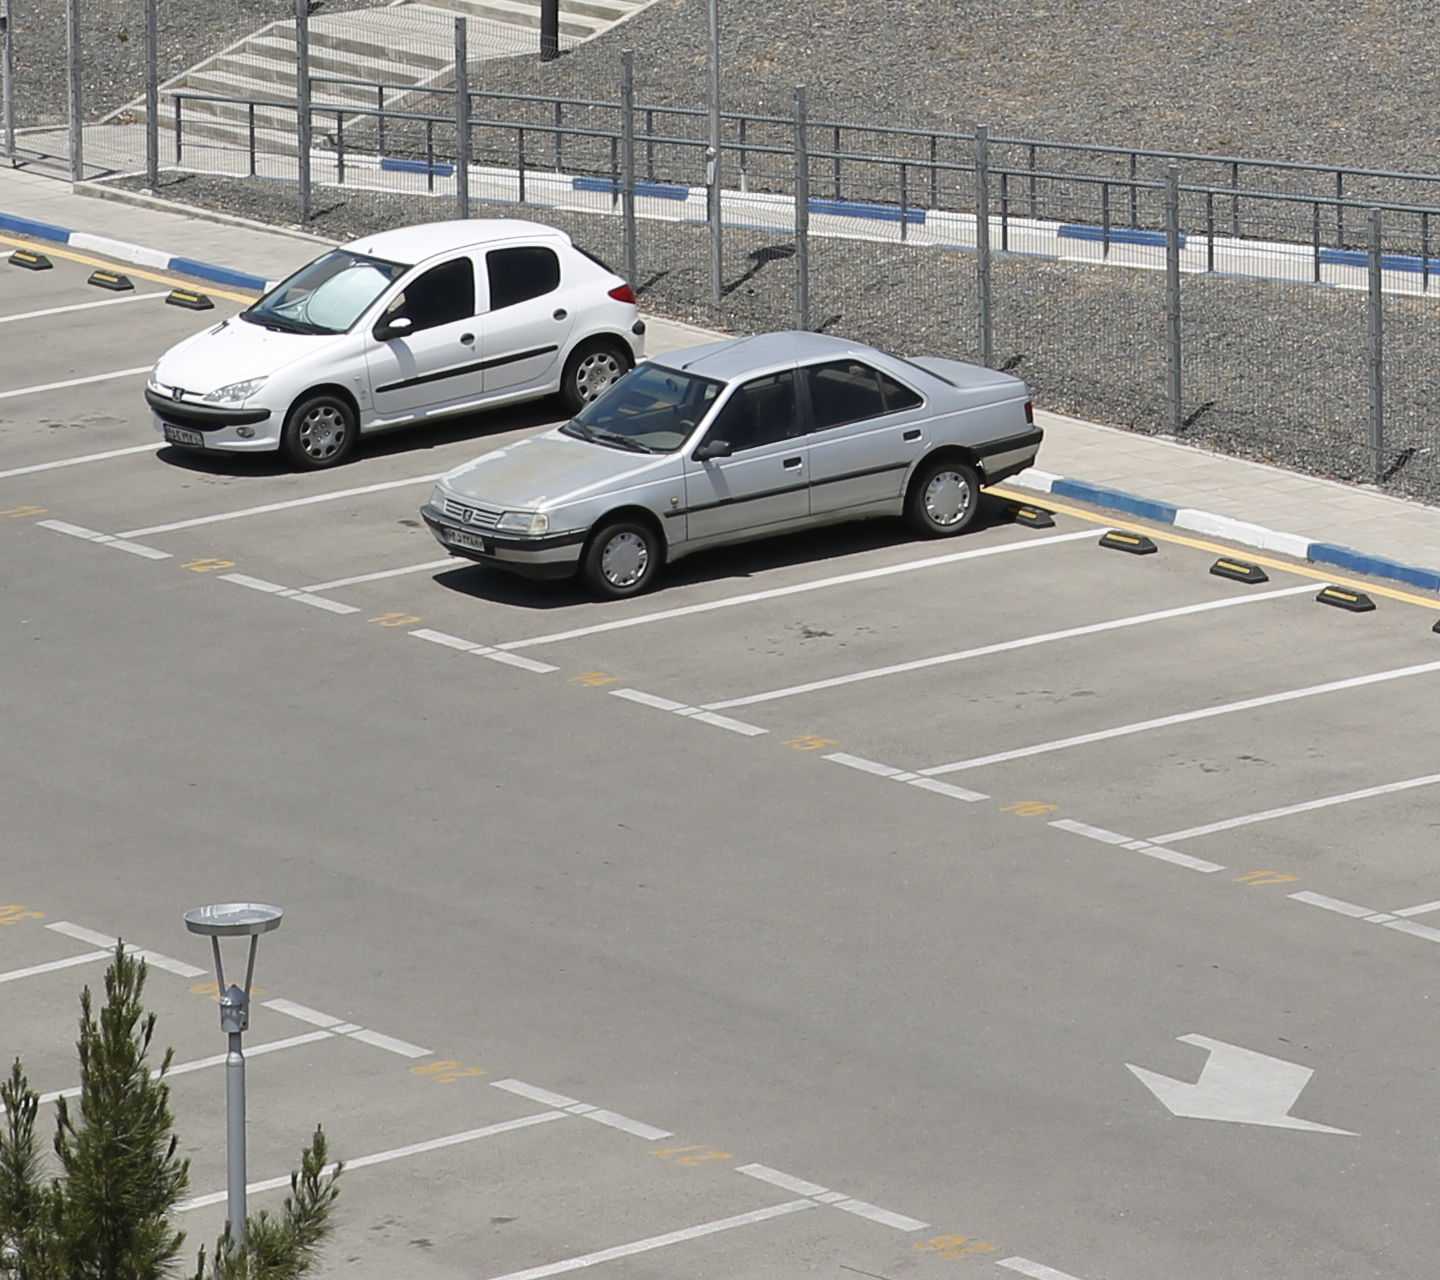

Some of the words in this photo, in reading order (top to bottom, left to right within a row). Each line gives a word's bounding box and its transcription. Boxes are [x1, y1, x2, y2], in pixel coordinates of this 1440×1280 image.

[1, 505, 48, 518] 11
[182, 557, 236, 573] 12
[369, 612, 422, 627] 13
[568, 671, 623, 687] 14
[780, 734, 840, 751] 15
[1000, 800, 1061, 816] 16
[1235, 870, 1300, 886] 17
[411, 1060, 488, 1083] 28
[650, 1144, 734, 1166] 27
[914, 1234, 997, 1260] 26
